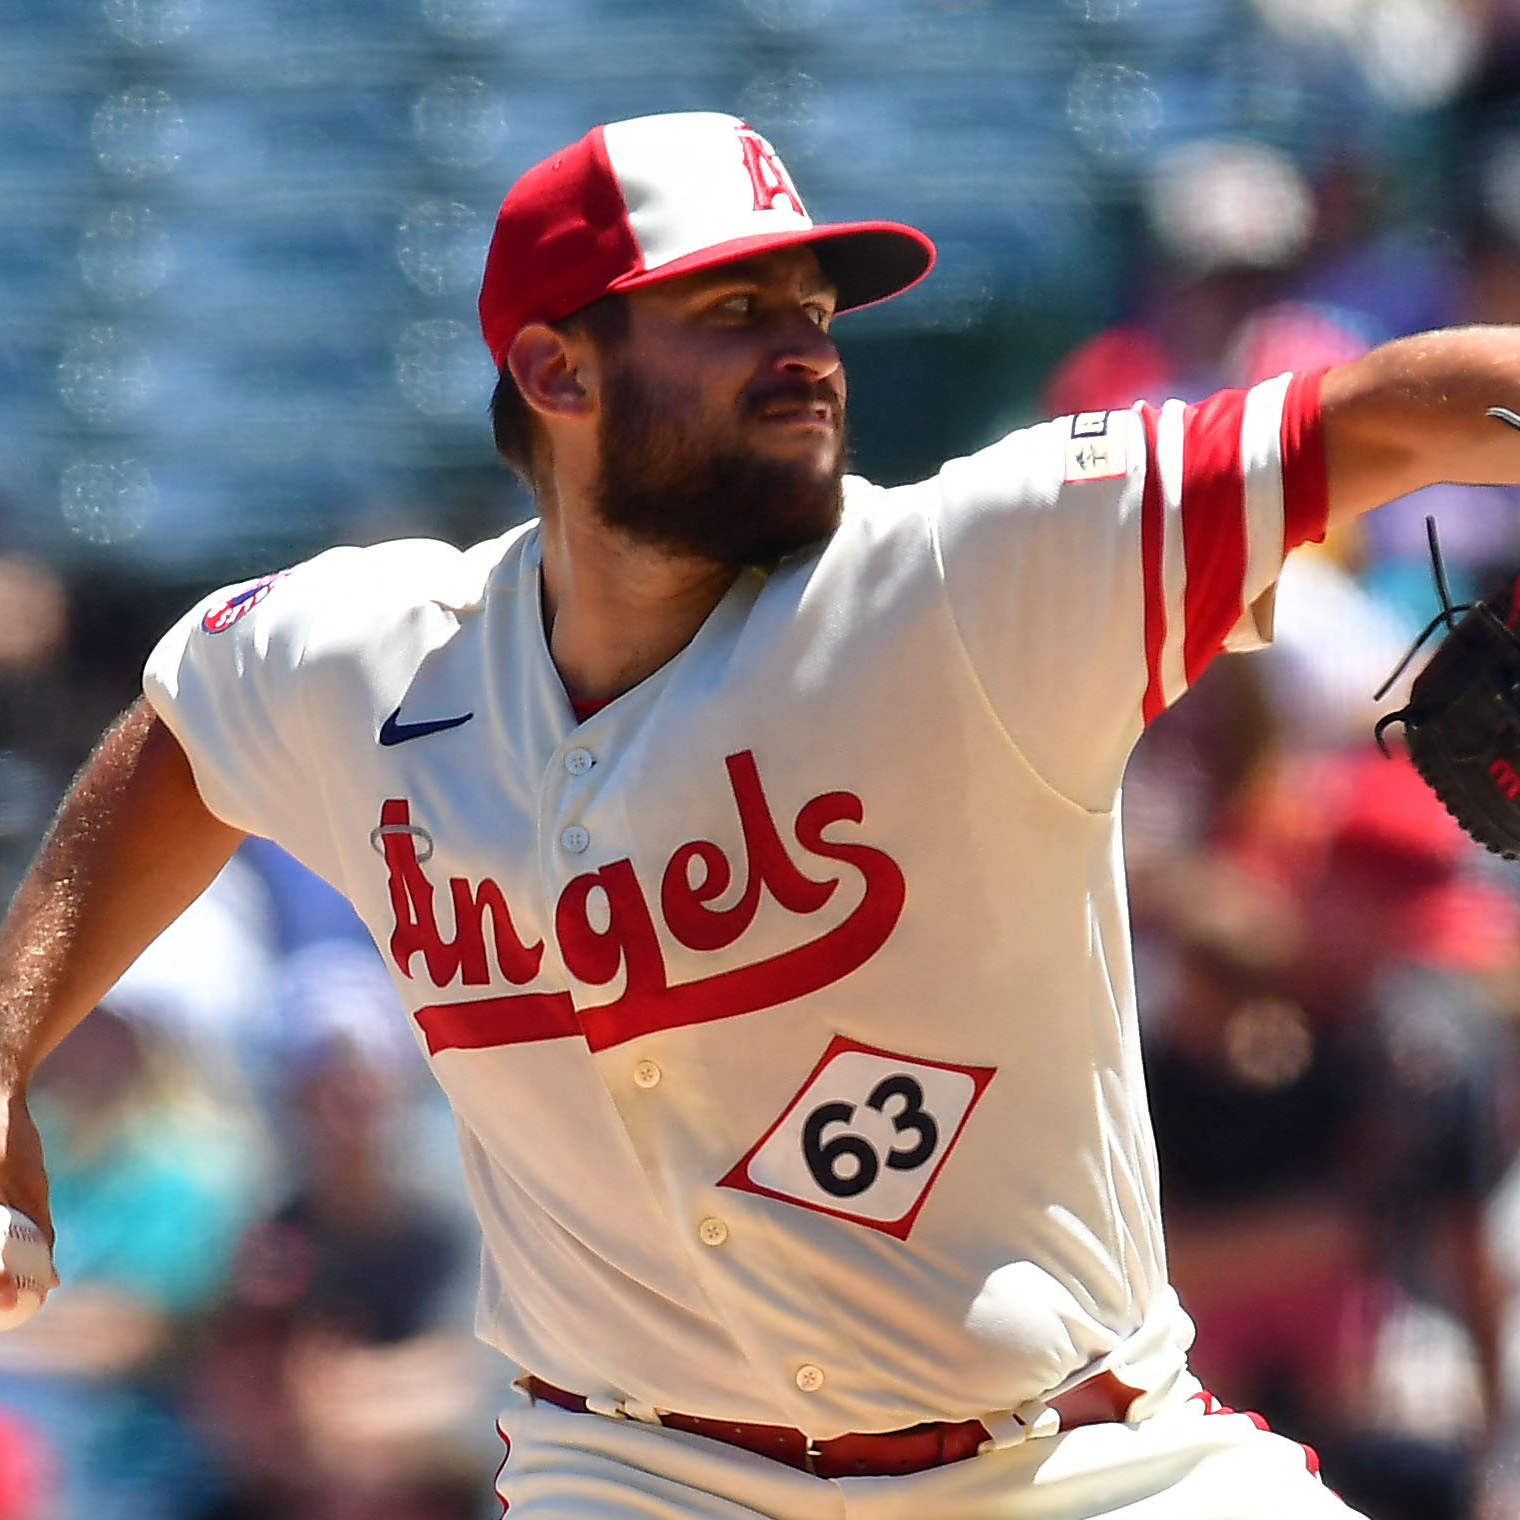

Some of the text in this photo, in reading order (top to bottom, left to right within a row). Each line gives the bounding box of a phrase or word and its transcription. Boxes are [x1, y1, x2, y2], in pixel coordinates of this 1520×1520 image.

[735, 123, 808, 217] A
[375, 748, 909, 1056] Angels
[801, 1075, 939, 1200] 63
